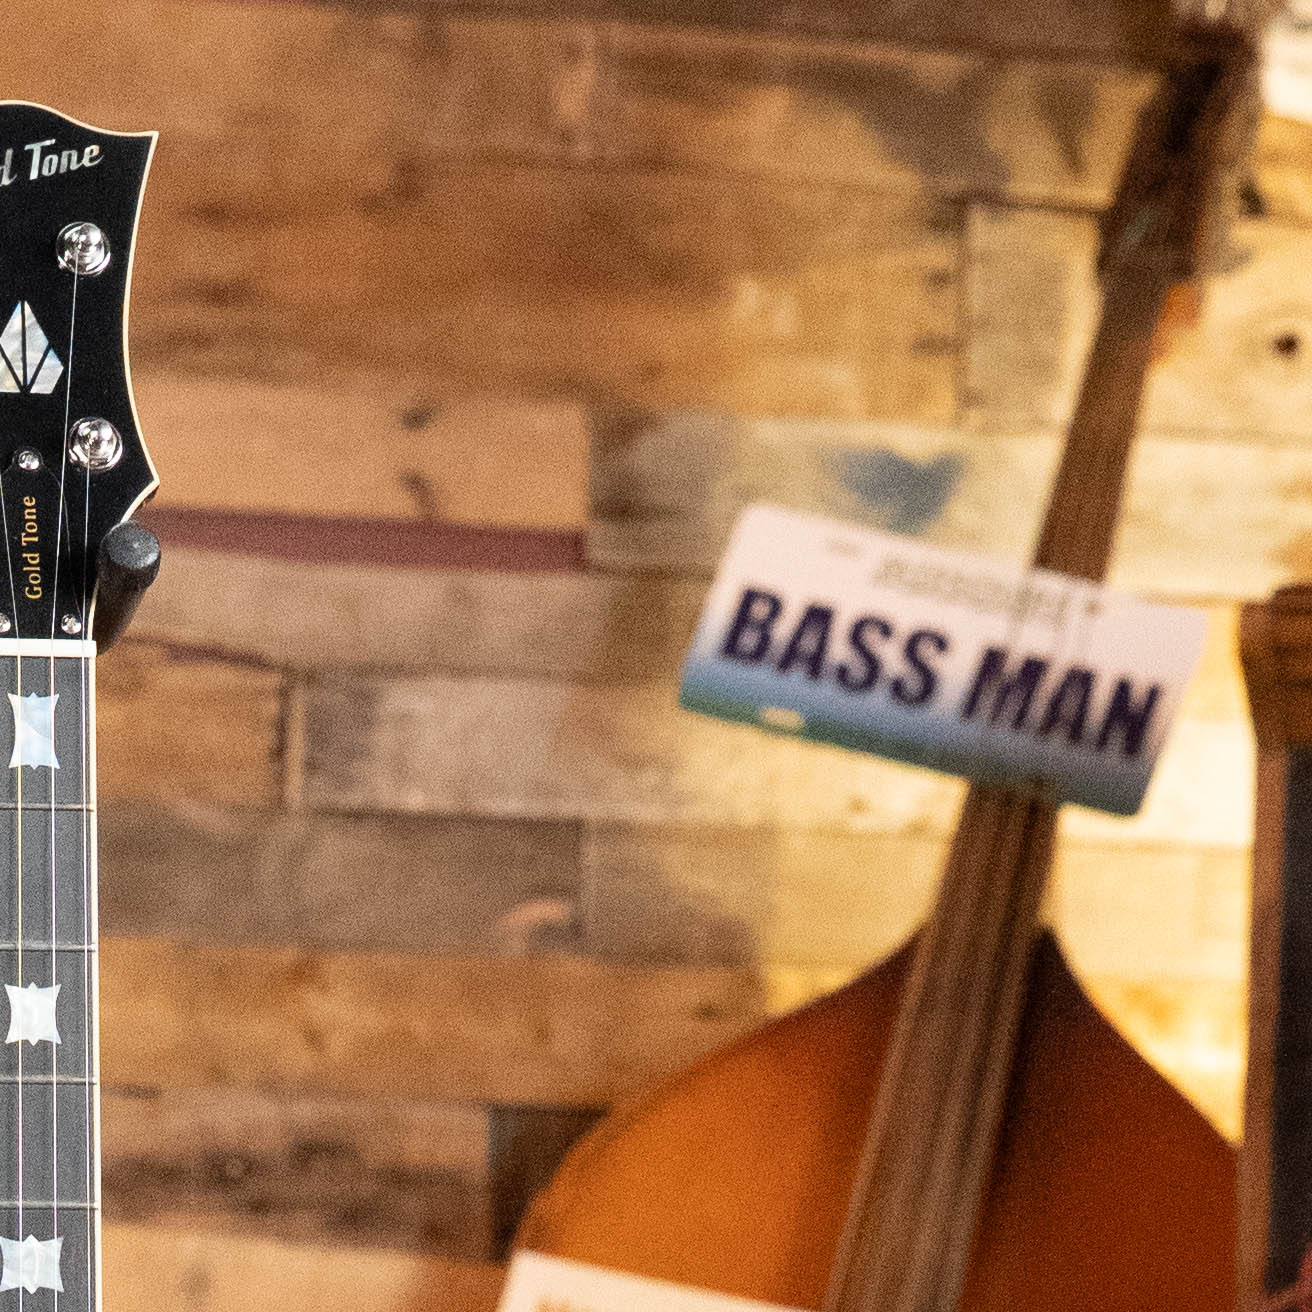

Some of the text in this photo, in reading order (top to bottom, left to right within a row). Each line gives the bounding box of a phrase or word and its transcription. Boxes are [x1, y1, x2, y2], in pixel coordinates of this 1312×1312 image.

[24, 138, 105, 181] Tone
[20, 495, 43, 600] Gold Tone
[719, 585, 950, 708] BASS
[961, 643, 1161, 758] MAN
